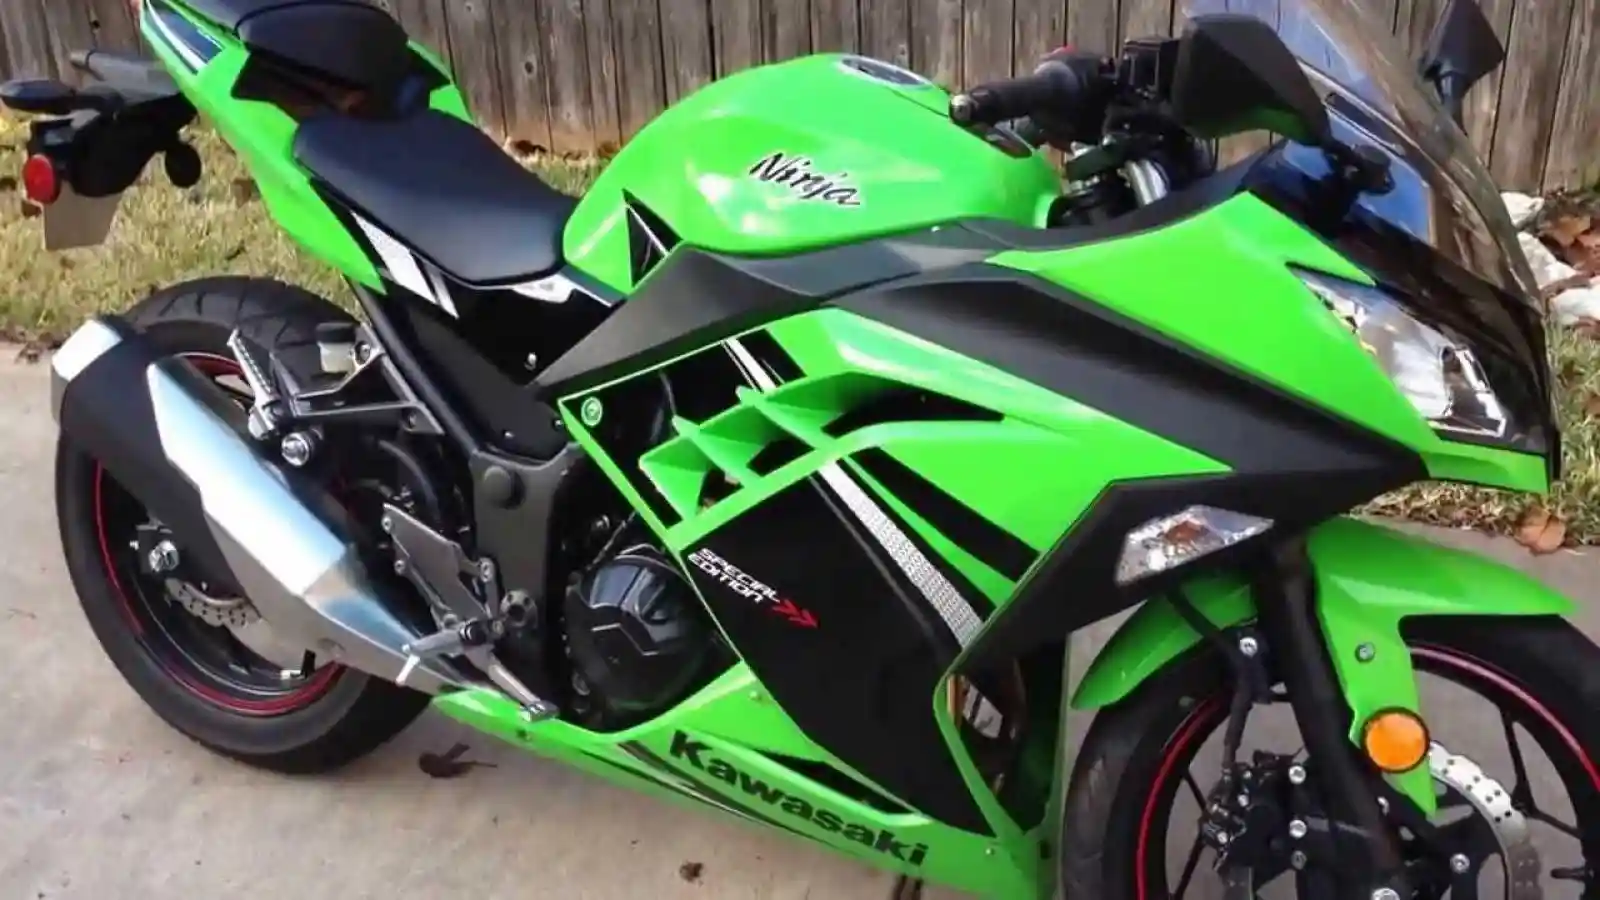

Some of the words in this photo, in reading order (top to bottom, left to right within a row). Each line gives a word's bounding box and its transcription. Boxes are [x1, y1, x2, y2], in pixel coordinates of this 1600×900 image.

[749, 152, 861, 206] Ninja
[688, 553, 763, 603] EDITION
[699, 548, 780, 602] SPECIAL
[669, 730, 929, 866] Kawasaki
